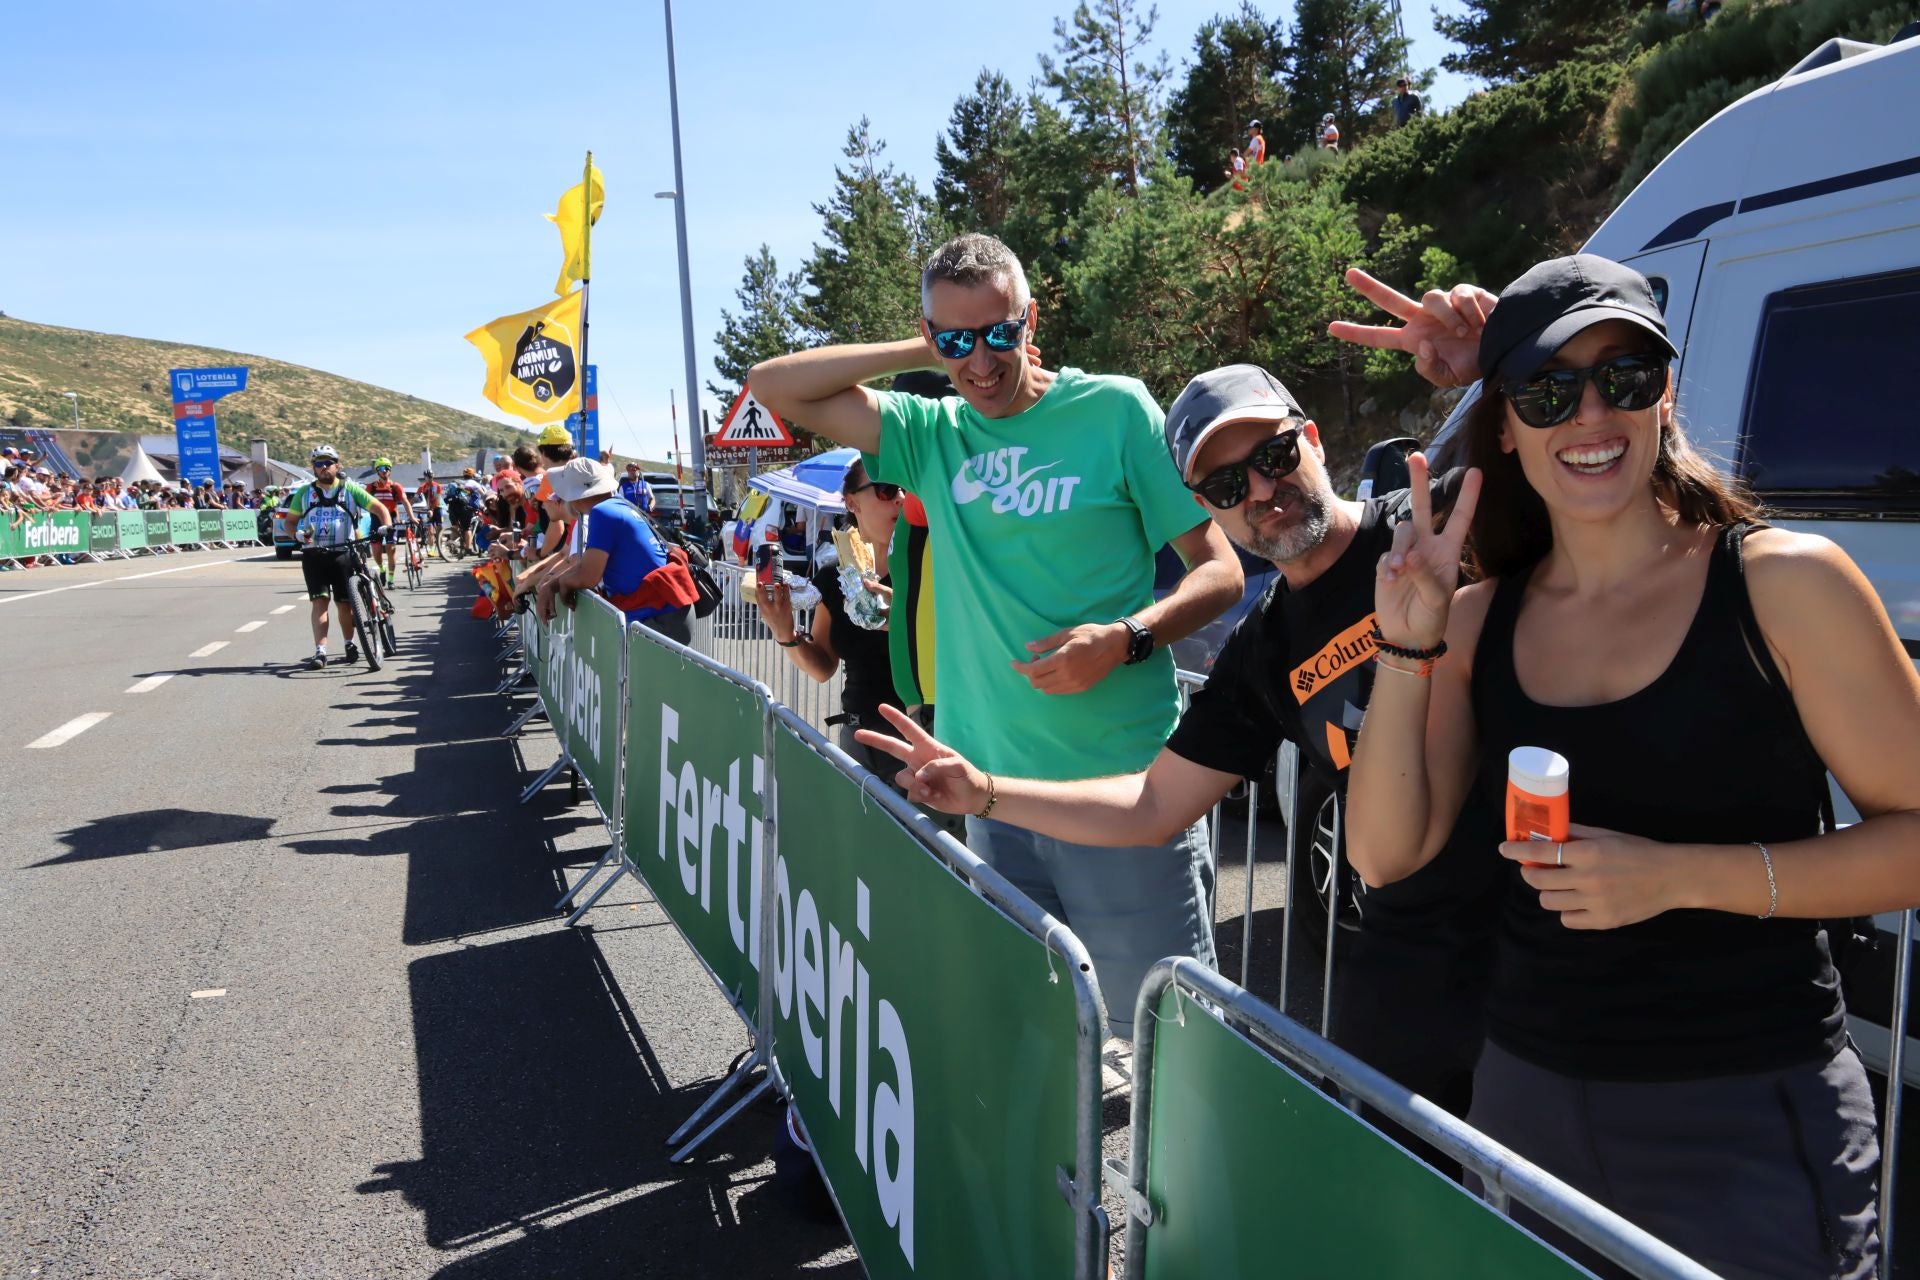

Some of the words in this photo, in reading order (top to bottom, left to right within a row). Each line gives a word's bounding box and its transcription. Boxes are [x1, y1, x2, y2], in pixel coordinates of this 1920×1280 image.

[708, 448, 768, 459] Navacerrda
[25, 519, 79, 548] Fertiberia
[1315, 618, 1379, 679] Colum
[547, 608, 601, 765] Fertberia
[658, 702, 914, 1272] Fertiberia
